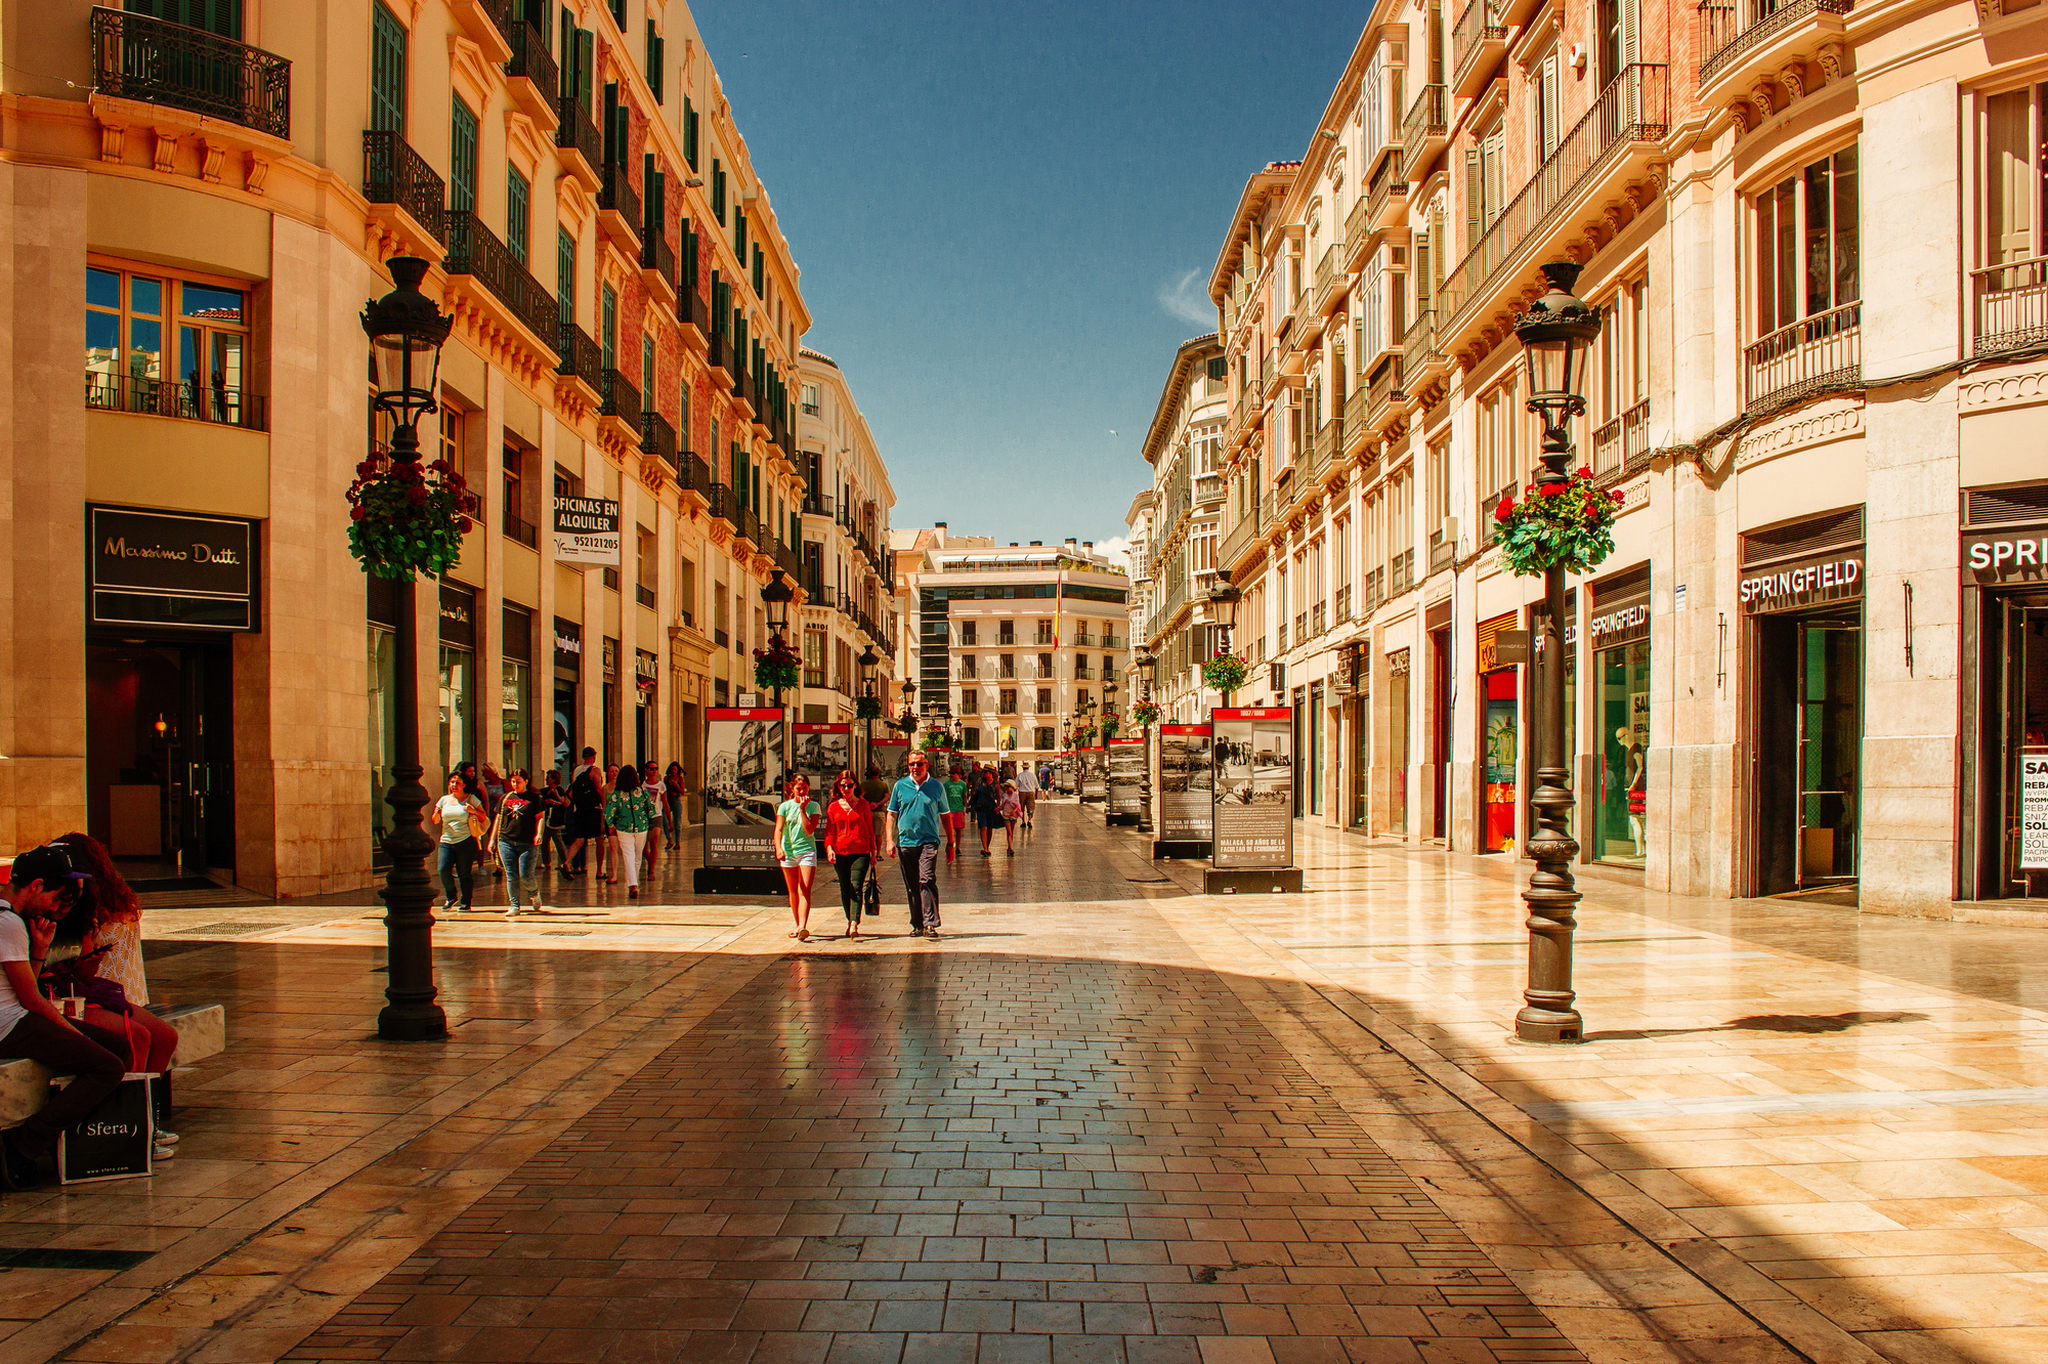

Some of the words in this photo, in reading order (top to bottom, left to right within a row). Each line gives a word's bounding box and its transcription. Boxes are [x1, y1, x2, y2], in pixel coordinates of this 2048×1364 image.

[554, 497, 601, 514] OFICINAS
[604, 502, 618, 516] EN
[559, 513, 610, 531] ALQUILER
[574, 536, 618, 549] 952121205
[104, 537, 187, 560] Massimo
[191, 543, 240, 565] Dutti
[1967, 538, 2048, 570] SPRI
[1740, 559, 1859, 602] SPRINGFIELD
[1591, 604, 1647, 637] SPRINGFIELD
[740, 698, 755, 706] COS
[760, 838, 768, 846] DE
[1220, 845, 1246, 853] FACULTAD
[1254, 837, 1270, 846] AÑOS
[1270, 838, 1278, 846] DE
[1278, 838, 1286, 846] LA
[87, 1121, 128, 1136] Sfera
